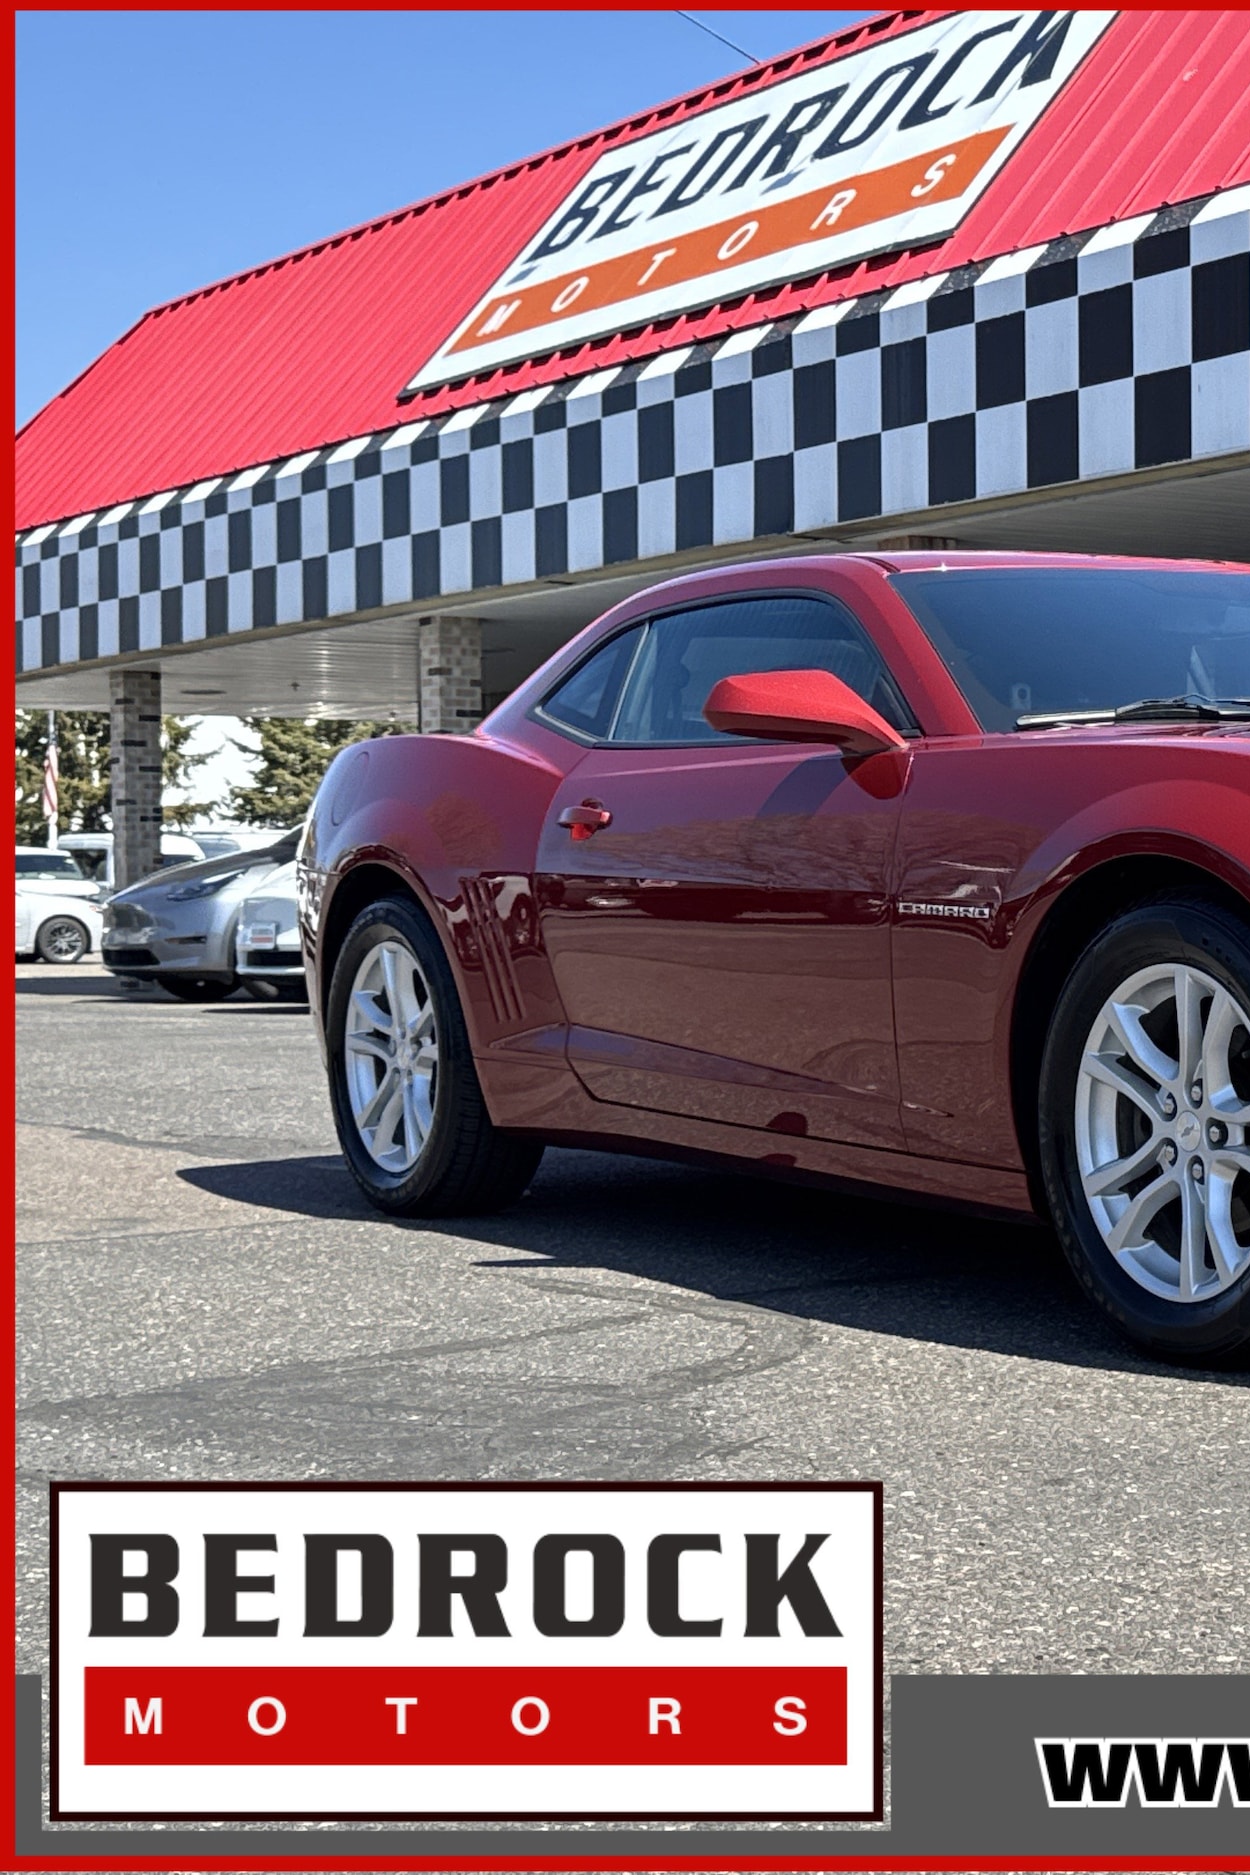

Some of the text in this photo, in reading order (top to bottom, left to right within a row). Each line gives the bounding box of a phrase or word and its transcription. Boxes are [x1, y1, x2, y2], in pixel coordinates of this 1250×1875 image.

[525, 10, 1077, 266] BEDROCK
[477, 153, 957, 338] MOTORS
[898, 902, 990, 919] CAMARO
